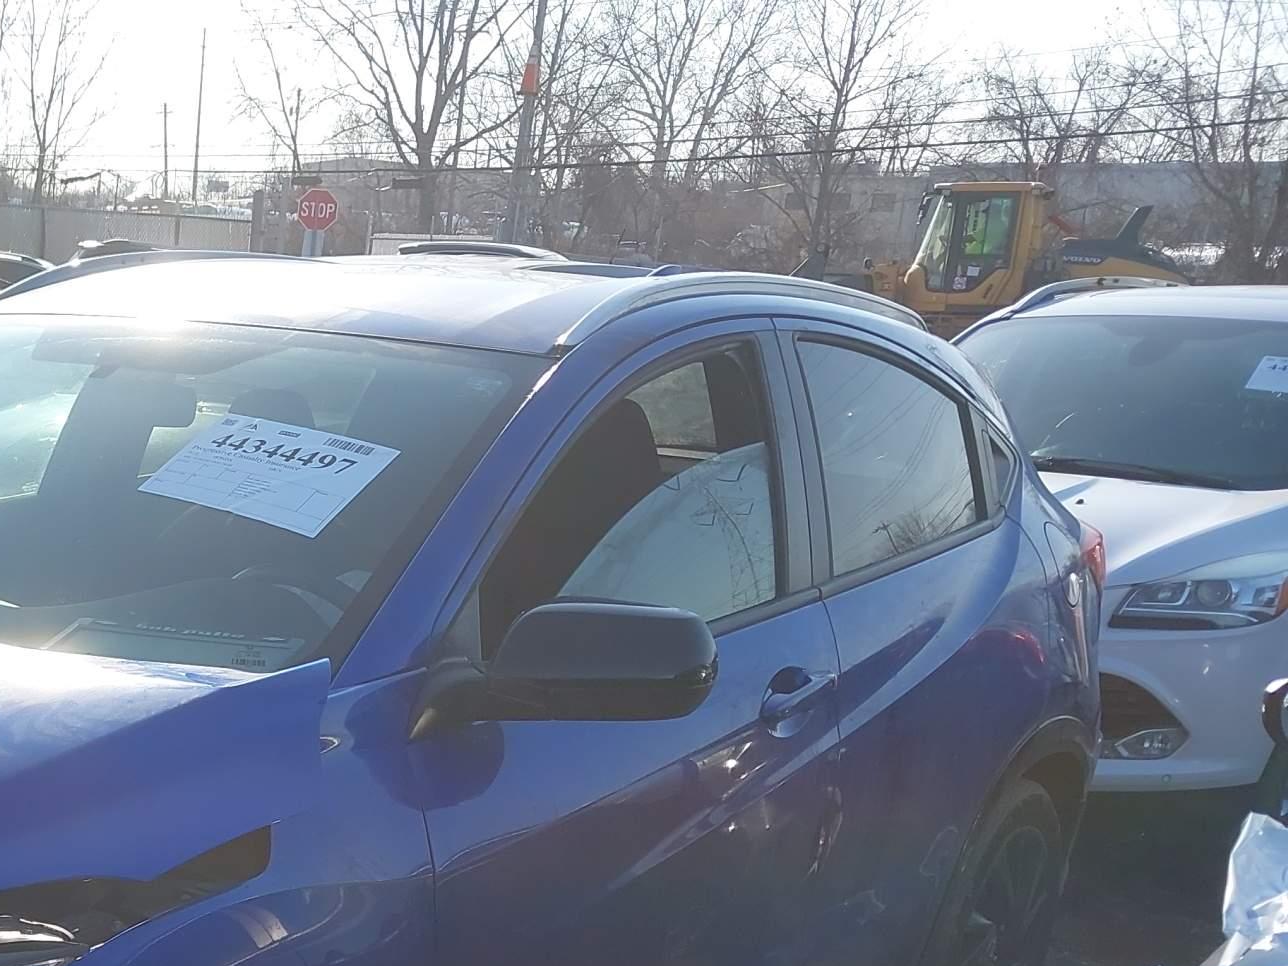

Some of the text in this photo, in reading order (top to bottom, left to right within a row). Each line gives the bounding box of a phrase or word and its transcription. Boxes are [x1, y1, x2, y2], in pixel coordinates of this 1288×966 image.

[300, 201, 336, 219] STOP
[1062, 255, 1102, 264] VOLVO
[210, 433, 359, 474] 44344497
